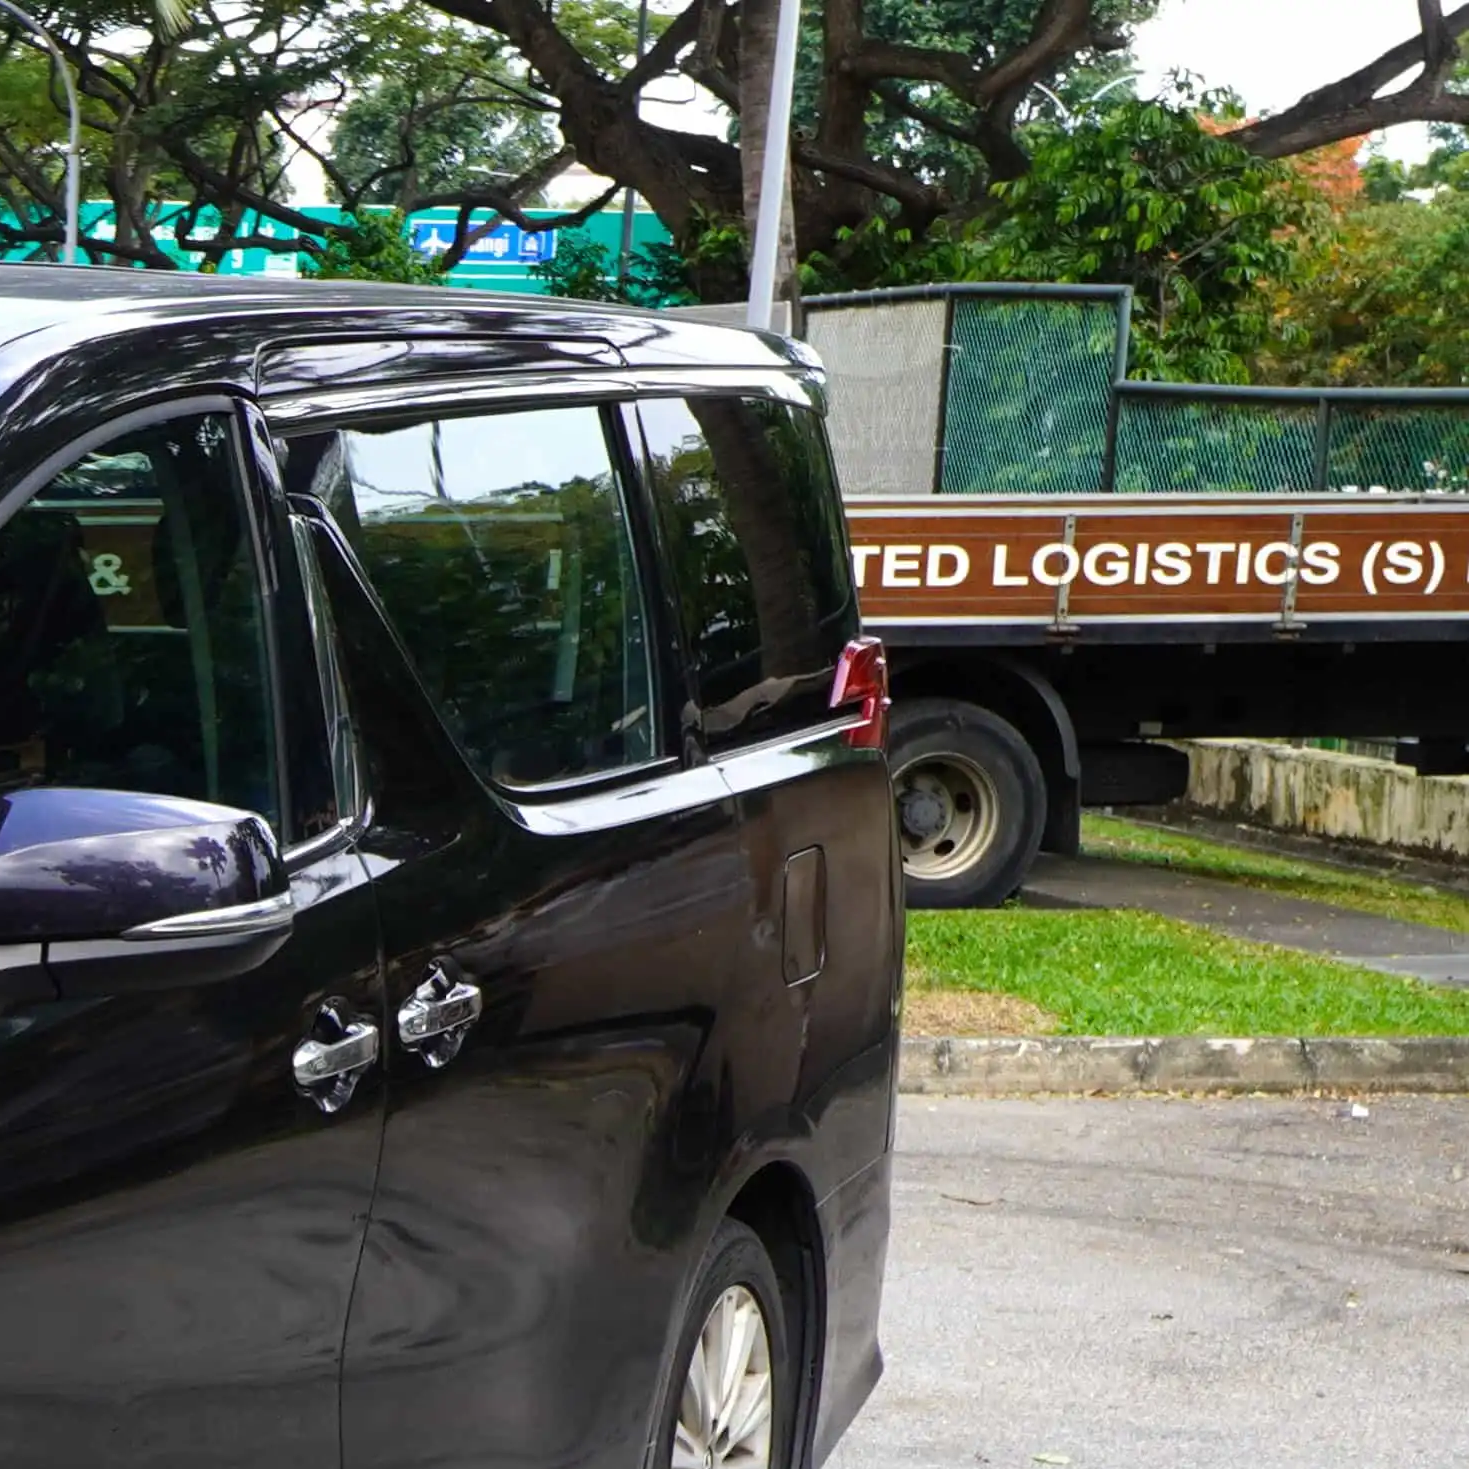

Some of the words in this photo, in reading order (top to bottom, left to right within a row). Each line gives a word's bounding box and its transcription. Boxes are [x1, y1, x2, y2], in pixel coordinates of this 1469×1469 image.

[850, 544, 971, 588] TED
[992, 541, 1341, 587] LOGISTICS
[1361, 540, 1446, 595] (S)
